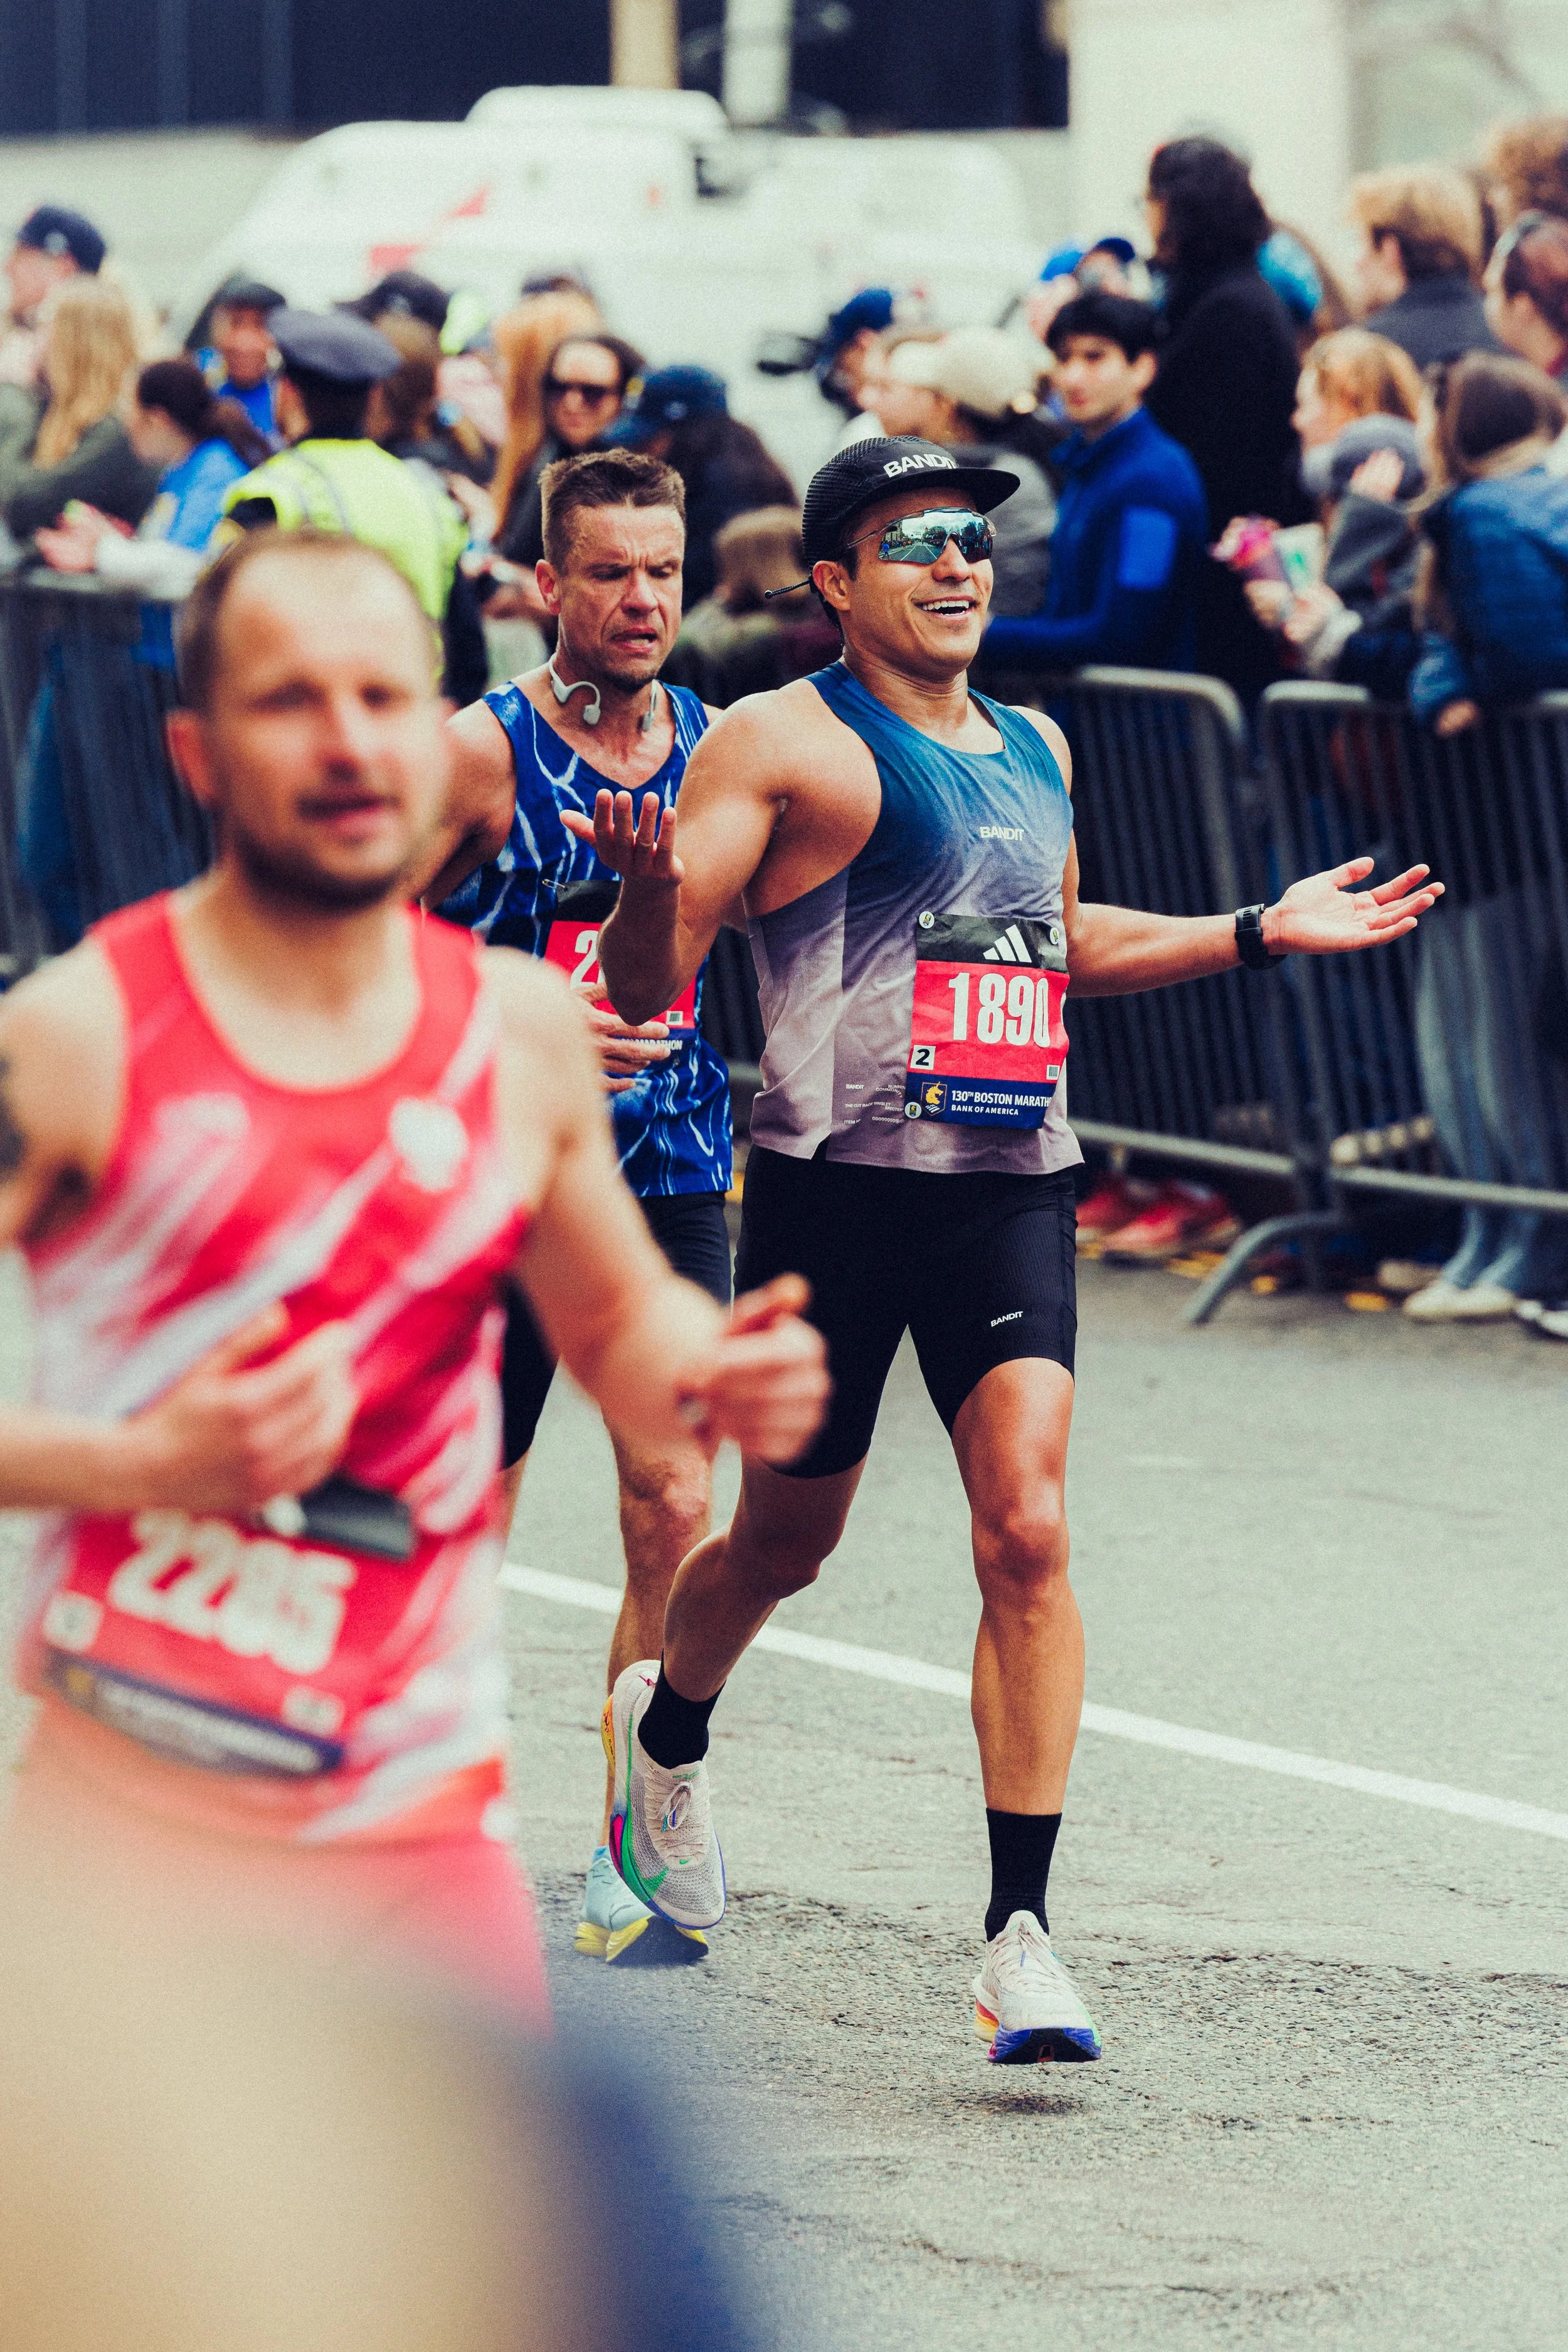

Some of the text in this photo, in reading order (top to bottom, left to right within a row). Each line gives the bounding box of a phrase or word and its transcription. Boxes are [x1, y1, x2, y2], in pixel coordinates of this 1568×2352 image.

[979, 825, 1024, 842] BANDIT
[948, 972, 1051, 1048] 1890
[915, 1048, 930, 1066] 2
[875, 1087, 903, 1098] COMMUNITY
[974, 1092, 1012, 1104] BOSTON
[1014, 1094, 1052, 1107] MARATH
[985, 1108, 1019, 1116] AMERICA
[990, 1311, 1024, 1327] BANDIT
